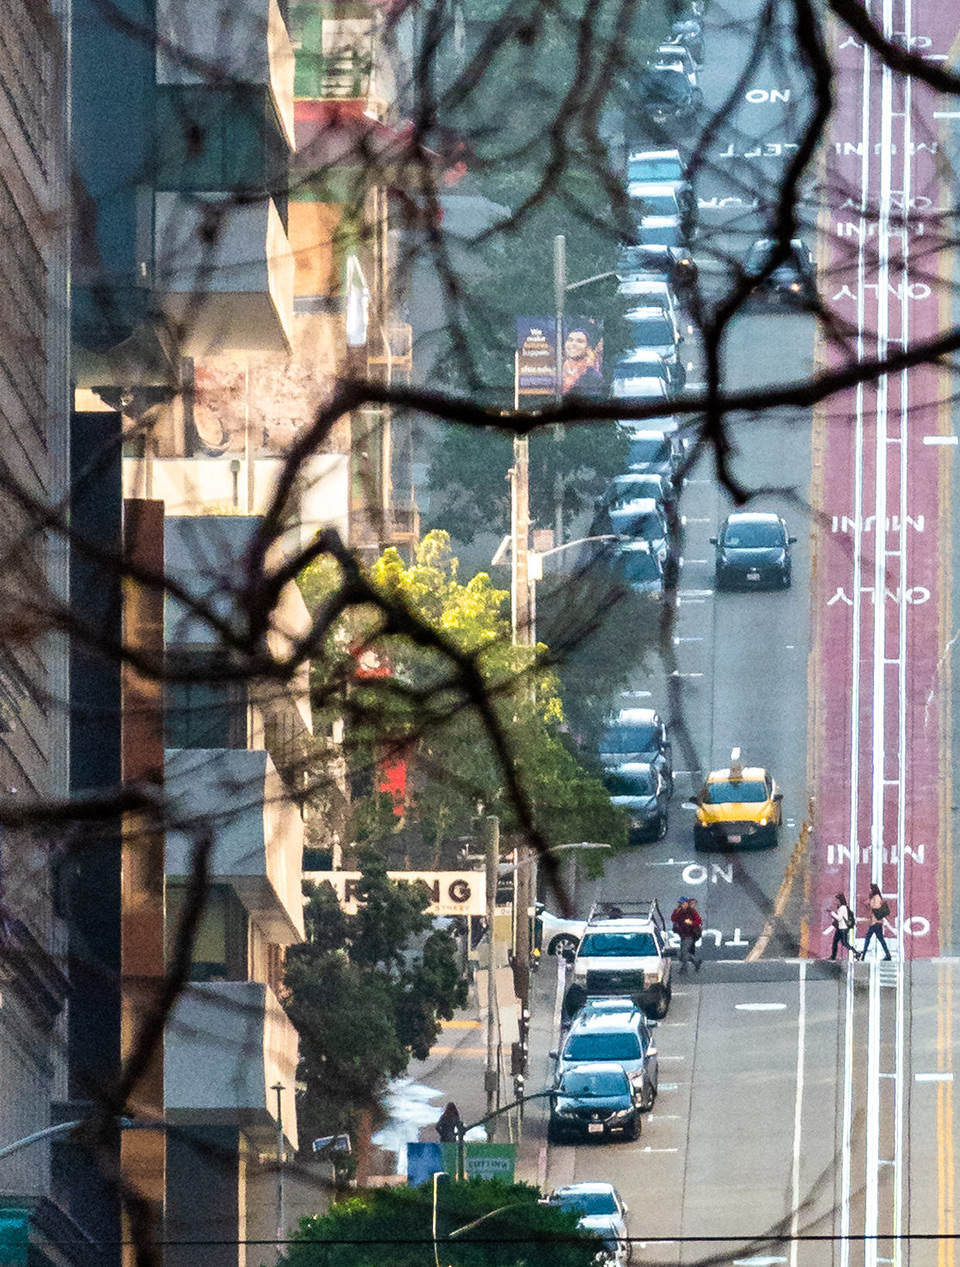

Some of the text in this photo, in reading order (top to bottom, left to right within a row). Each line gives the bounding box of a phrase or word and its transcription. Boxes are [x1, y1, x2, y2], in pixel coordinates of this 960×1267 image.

[745, 89, 791, 103] NO
[832, 283, 932, 301] ONLY
[832, 515, 925, 534] MUNI
[827, 586, 931, 606] ONLY
[826, 843, 925, 865] MUNI
[681, 863, 734, 885] NO
